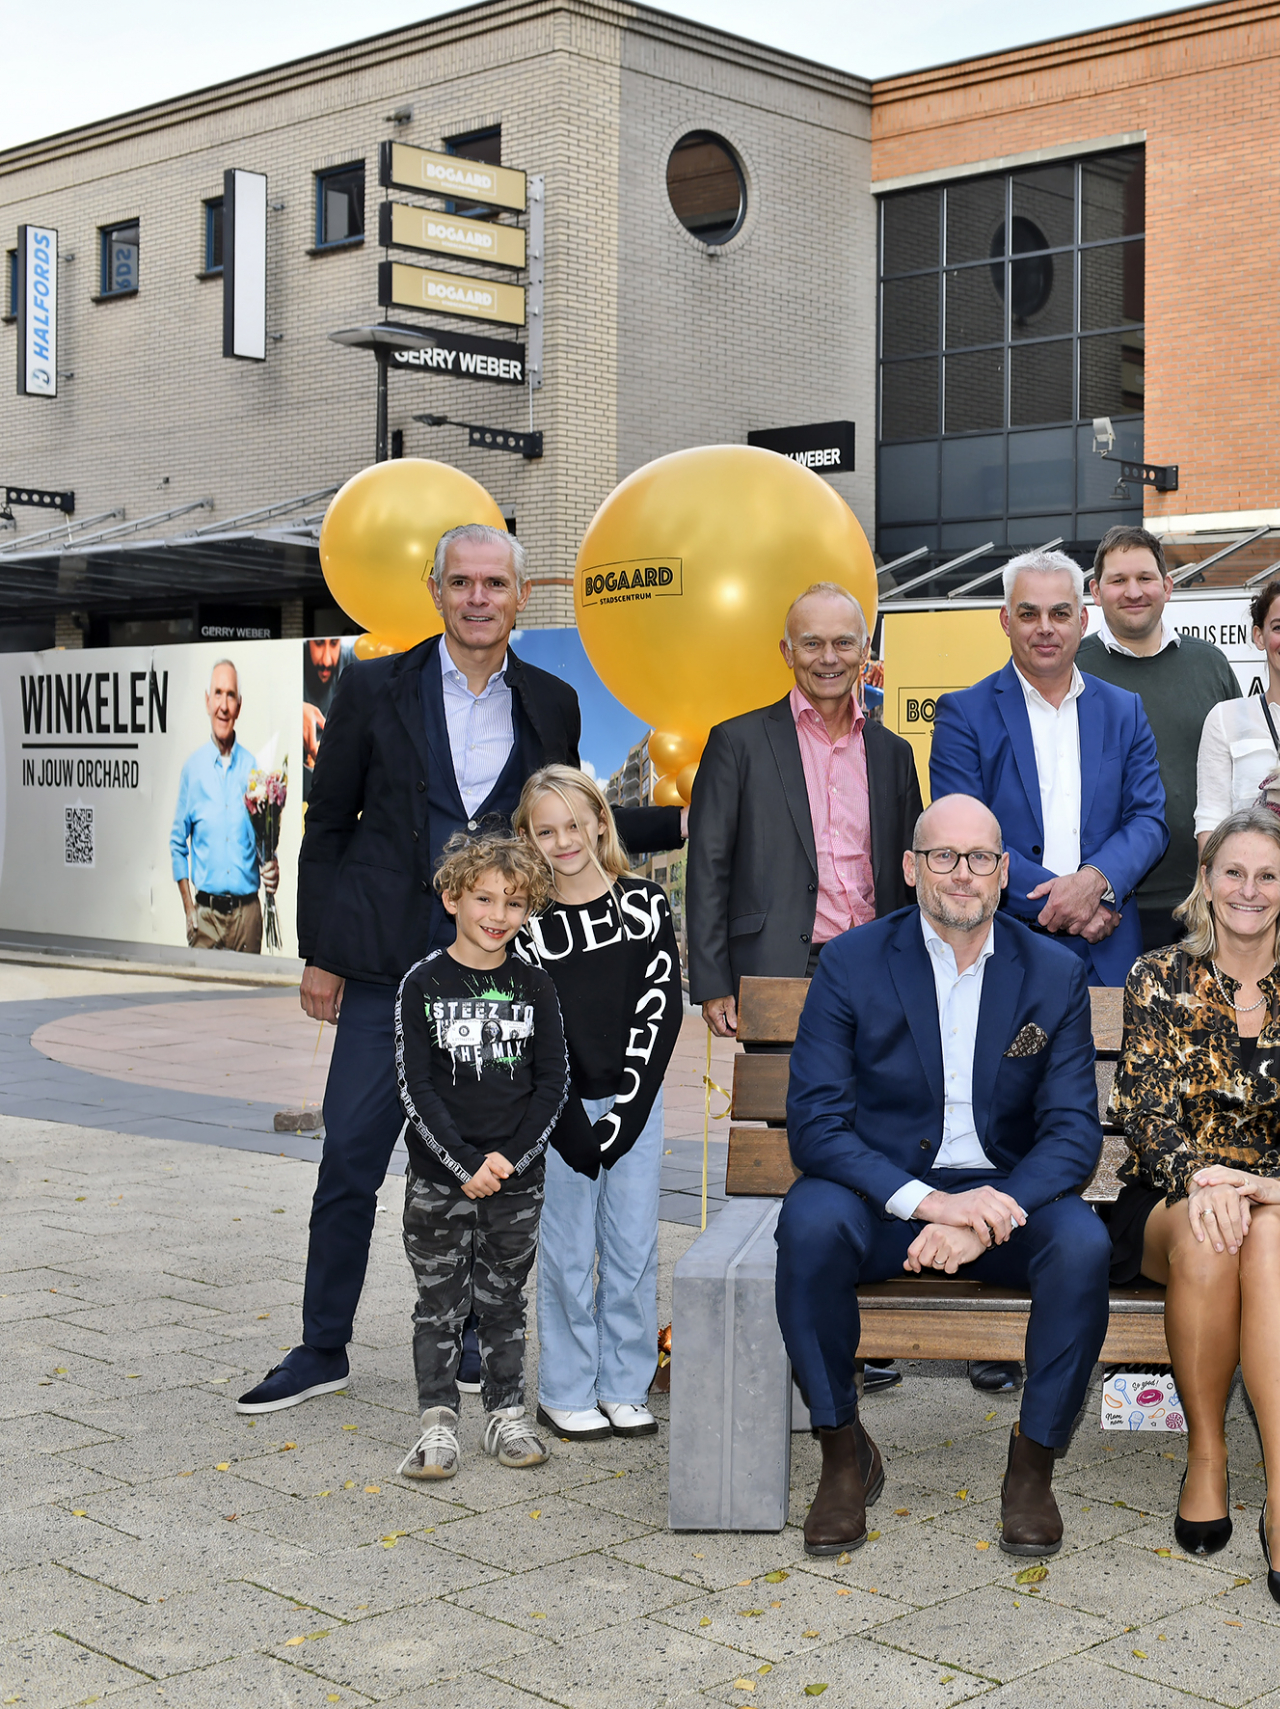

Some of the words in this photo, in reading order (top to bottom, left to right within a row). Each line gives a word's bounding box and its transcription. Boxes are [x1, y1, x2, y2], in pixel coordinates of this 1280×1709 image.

[426, 163, 492, 188] BOGAARD
[427, 222, 492, 247] BOGAARD
[33, 232, 51, 361] HALFORDS
[427, 282, 492, 306] BOGAARD
[394, 346, 456, 370] GERRY
[459, 351, 523, 381] WEBER
[795, 447, 841, 468] WEBER
[585, 566, 674, 597] BOGAARD
[599, 592, 652, 606] STADSCENTRUM
[201, 626, 235, 638] GERRY
[236, 627, 271, 639] WEBER
[1203, 624, 1217, 645] IS
[1220, 624, 1247, 645] EEN
[20, 670, 169, 734] WINKELEN
[22, 758, 35, 786] IN
[37, 758, 74, 788] JOUW
[76, 759, 139, 789] ORCHARD
[433, 1001, 500, 1020] STEEZ
[511, 1004, 534, 1022] TO
[448, 1044, 483, 1063] THE
[492, 1040, 523, 1059] MAX
